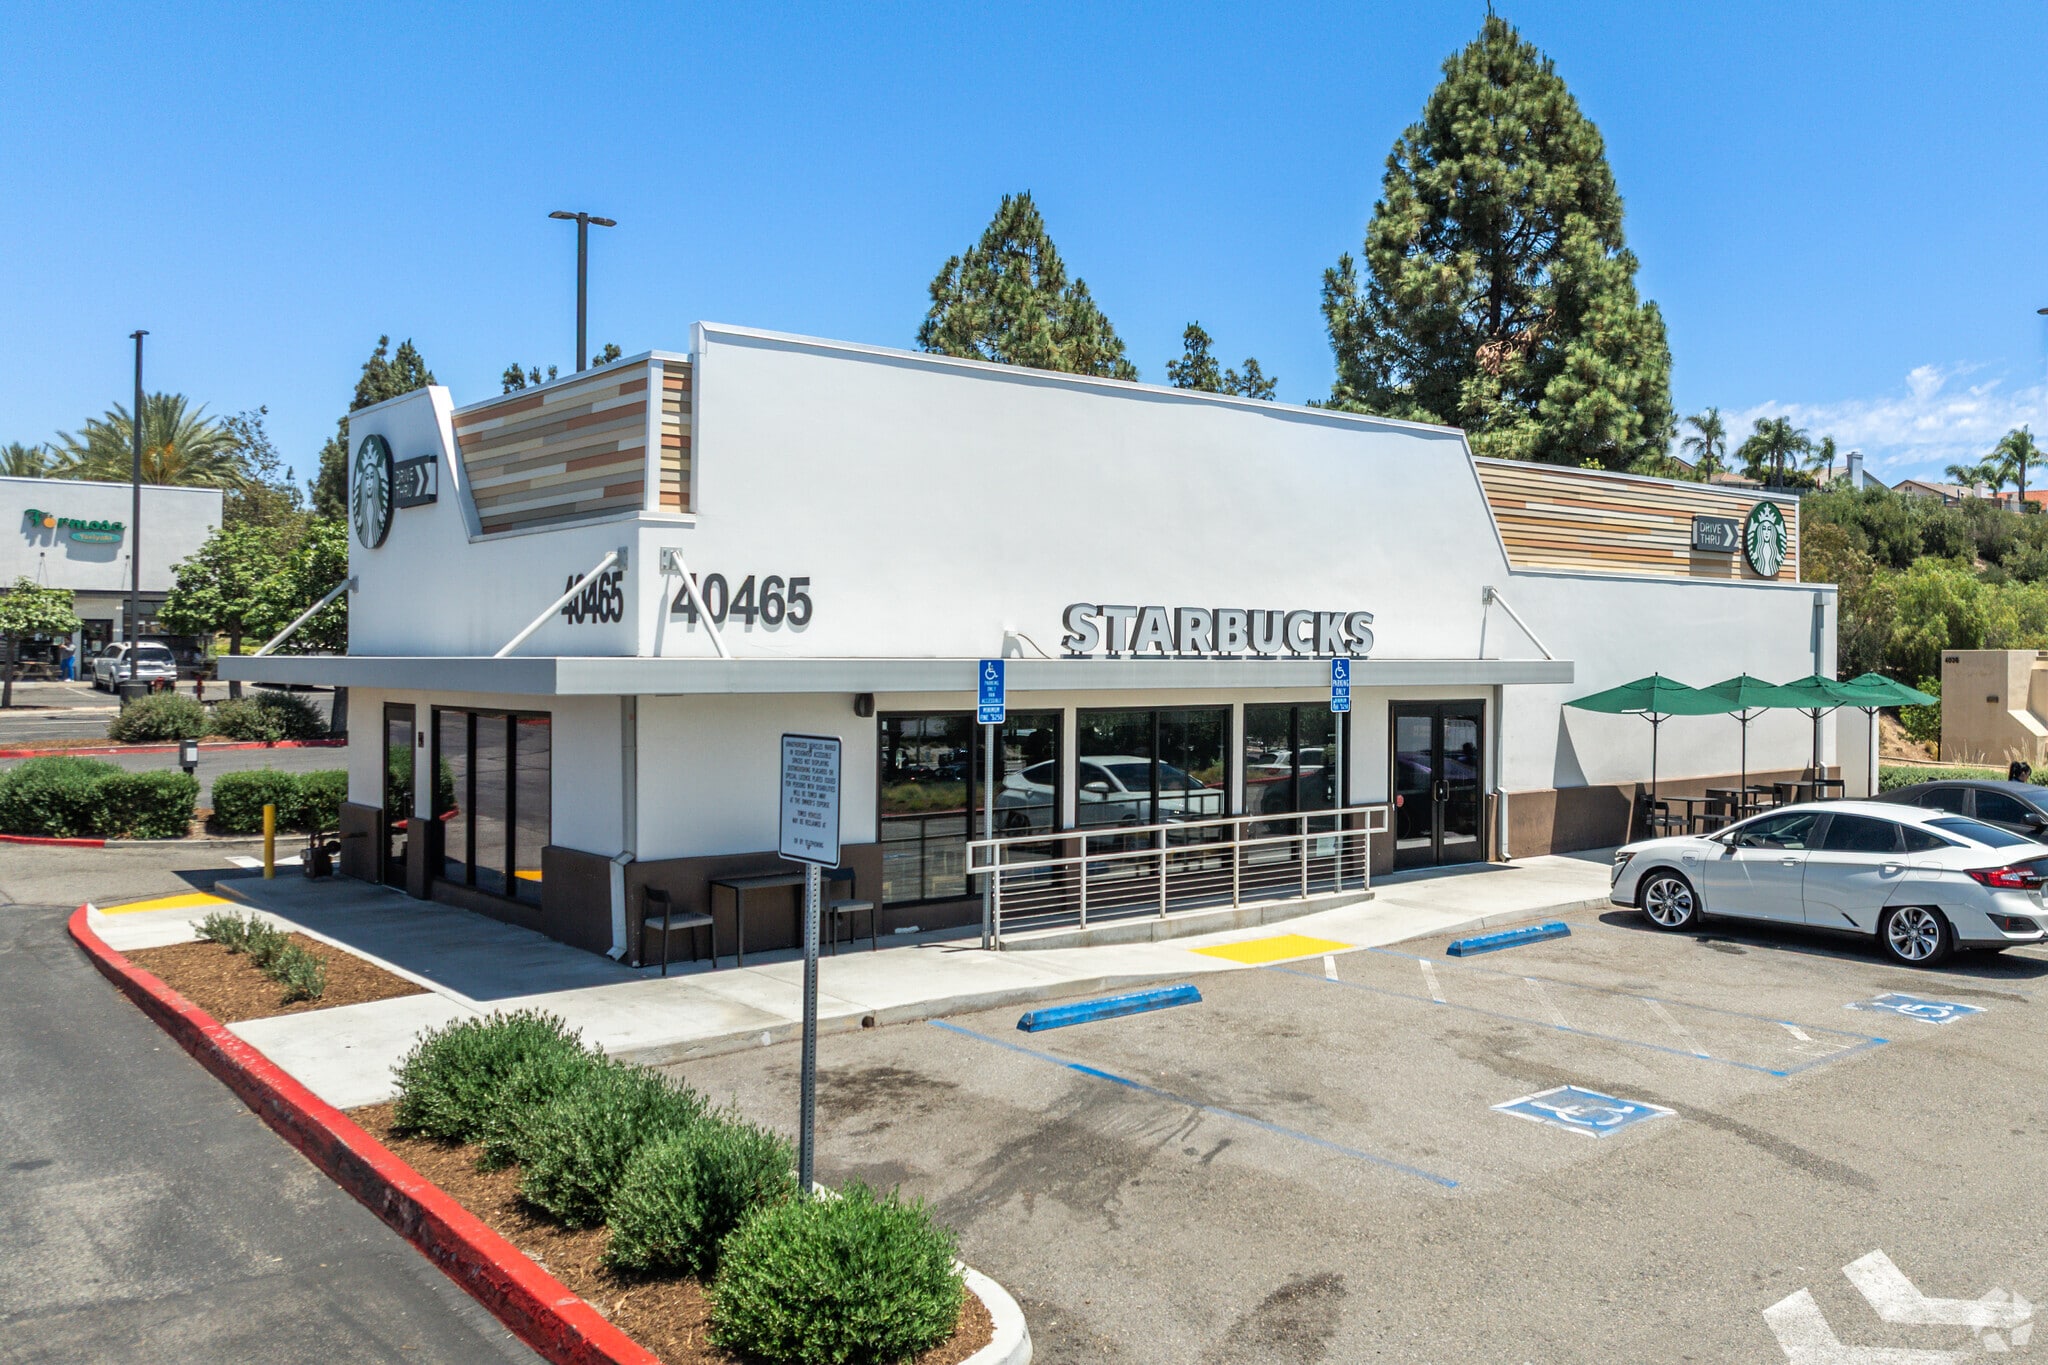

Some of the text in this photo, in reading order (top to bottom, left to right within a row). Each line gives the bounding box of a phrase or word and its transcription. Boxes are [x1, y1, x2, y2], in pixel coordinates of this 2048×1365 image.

[1699, 522, 1722, 534] DRIVE
[1700, 533, 1720, 546] THRU
[561, 570, 624, 625] 40465
[671, 572, 813, 626] 40465
[1060, 602, 1374, 654] STARBUCKS
[1333, 679, 1349, 687] PARKING
[1336, 688, 1346, 696] ONLY
